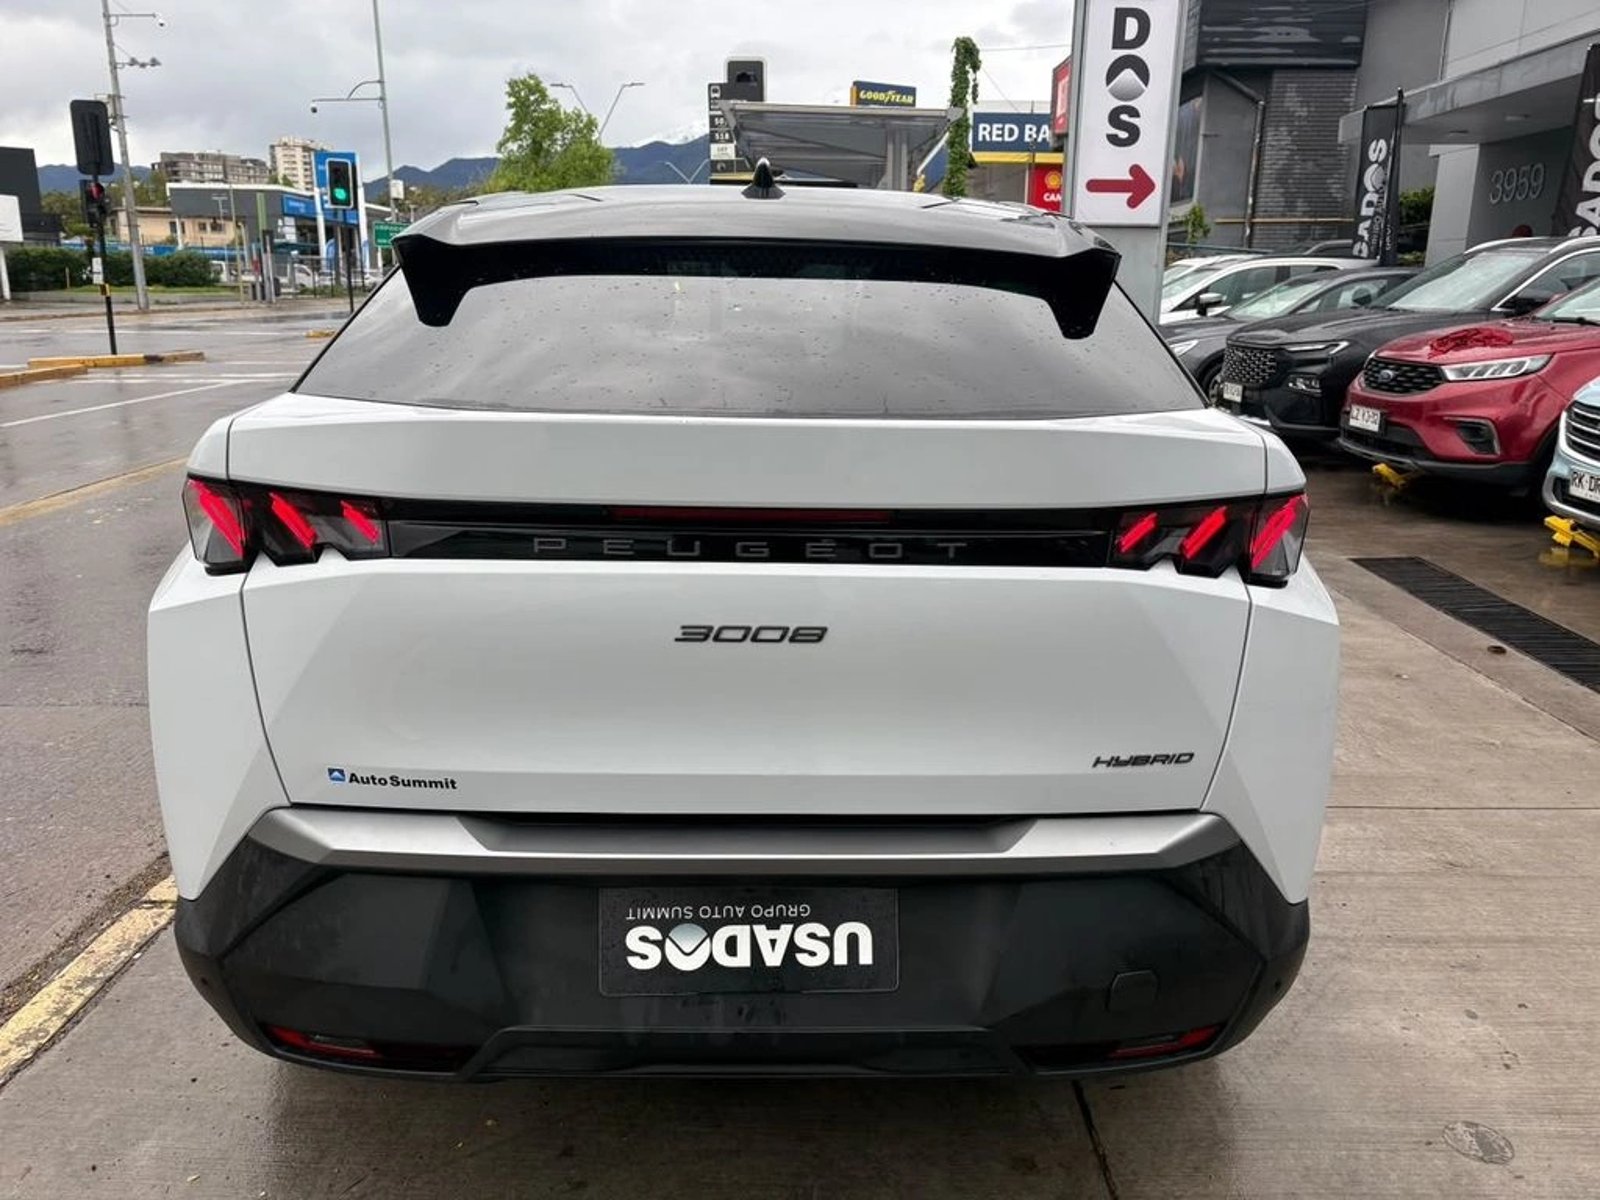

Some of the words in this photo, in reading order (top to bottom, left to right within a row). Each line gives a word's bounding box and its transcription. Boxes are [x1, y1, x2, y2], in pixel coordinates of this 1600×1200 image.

[860, 90, 914, 104] GOODYEAR
[978, 123, 1019, 142] RED
[1490, 163, 1545, 205] 3959
[534, 537, 968, 559] PEUGEOT
[674, 625, 828, 643] 3008
[1092, 752, 1195, 768] HYBRID
[625, 906, 693, 921] SUMMIT
[700, 905, 744, 919] AUTO
[750, 904, 811, 918] GRUPO
[625, 921, 873, 971] USADOS
